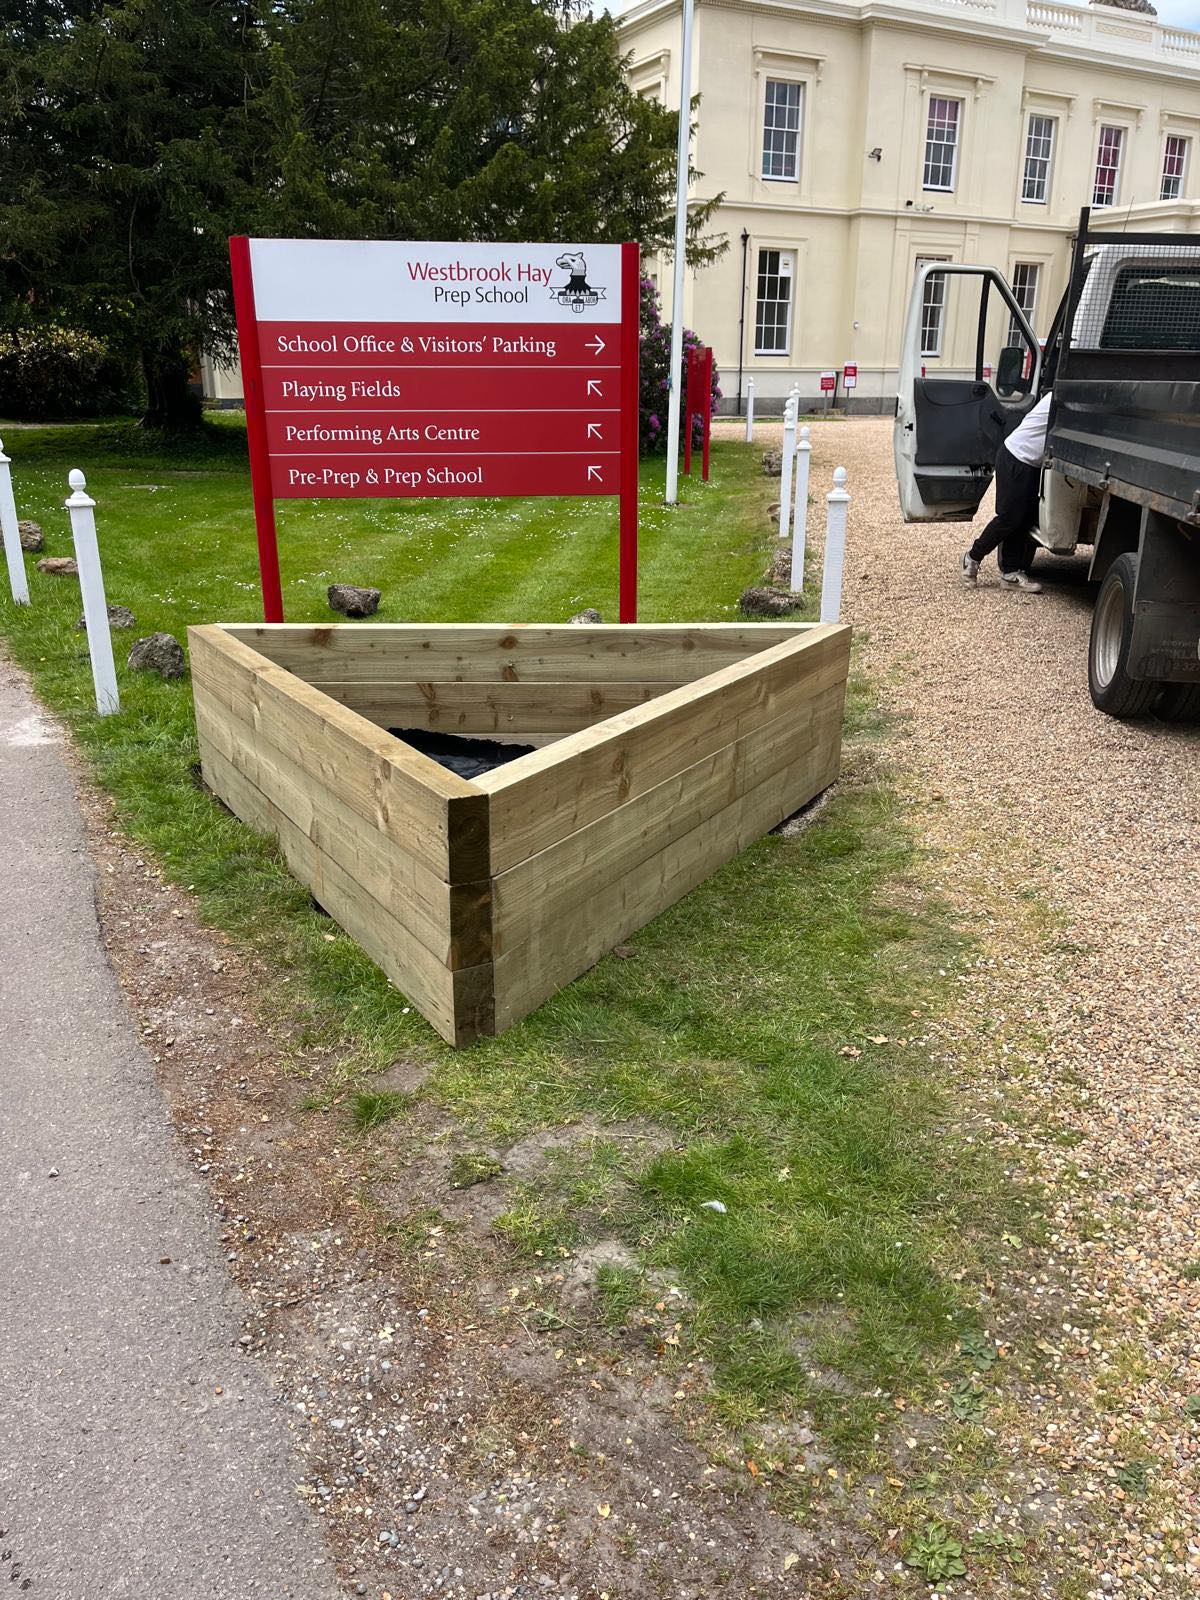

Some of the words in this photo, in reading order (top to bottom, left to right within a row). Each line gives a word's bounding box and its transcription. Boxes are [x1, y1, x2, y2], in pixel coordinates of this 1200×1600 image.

[407, 261, 511, 281] Westbrook
[518, 264, 553, 287] Hay
[435, 287, 470, 307] Prep
[476, 286, 528, 303] School
[278, 335, 337, 352] School
[344, 335, 395, 352] Office
[401, 337, 414, 352] &
[493, 336, 556, 357] Parking
[282, 381, 346, 401] Playing
[351, 381, 400, 397] Fields
[286, 425, 382, 444] Performing
[387, 426, 419, 440] Arts
[425, 425, 479, 440] Centre
[289, 469, 360, 488] Pre-Prep
[366, 469, 379, 484] &
[384, 469, 421, 487] Prep
[427, 467, 482, 483] School
